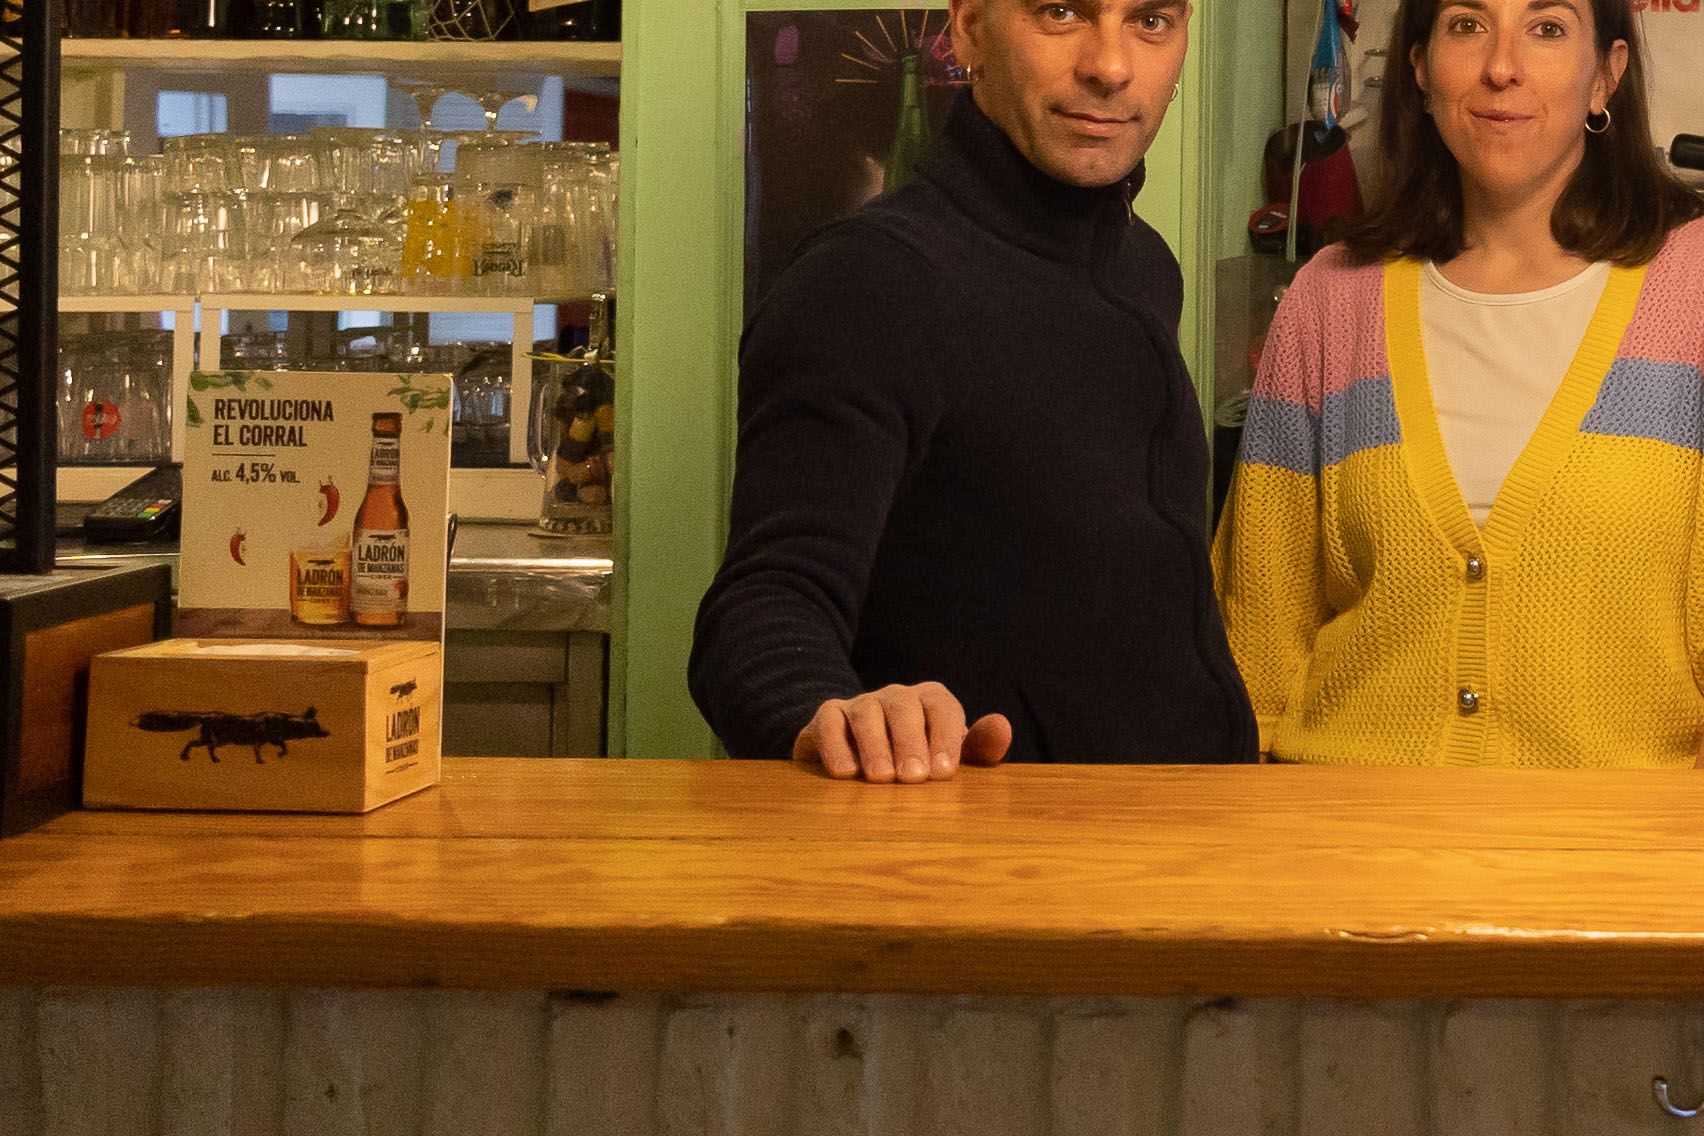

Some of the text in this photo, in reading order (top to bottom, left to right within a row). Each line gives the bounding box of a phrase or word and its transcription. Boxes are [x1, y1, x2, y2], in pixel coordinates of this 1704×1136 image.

[214, 398, 334, 422] REVOLUCIONA
[213, 425, 307, 447] EL CORRAL
[235, 462, 276, 484] 4,5%
[358, 543, 405, 562] LADRÓN
[296, 567, 344, 585] LADRÓN
